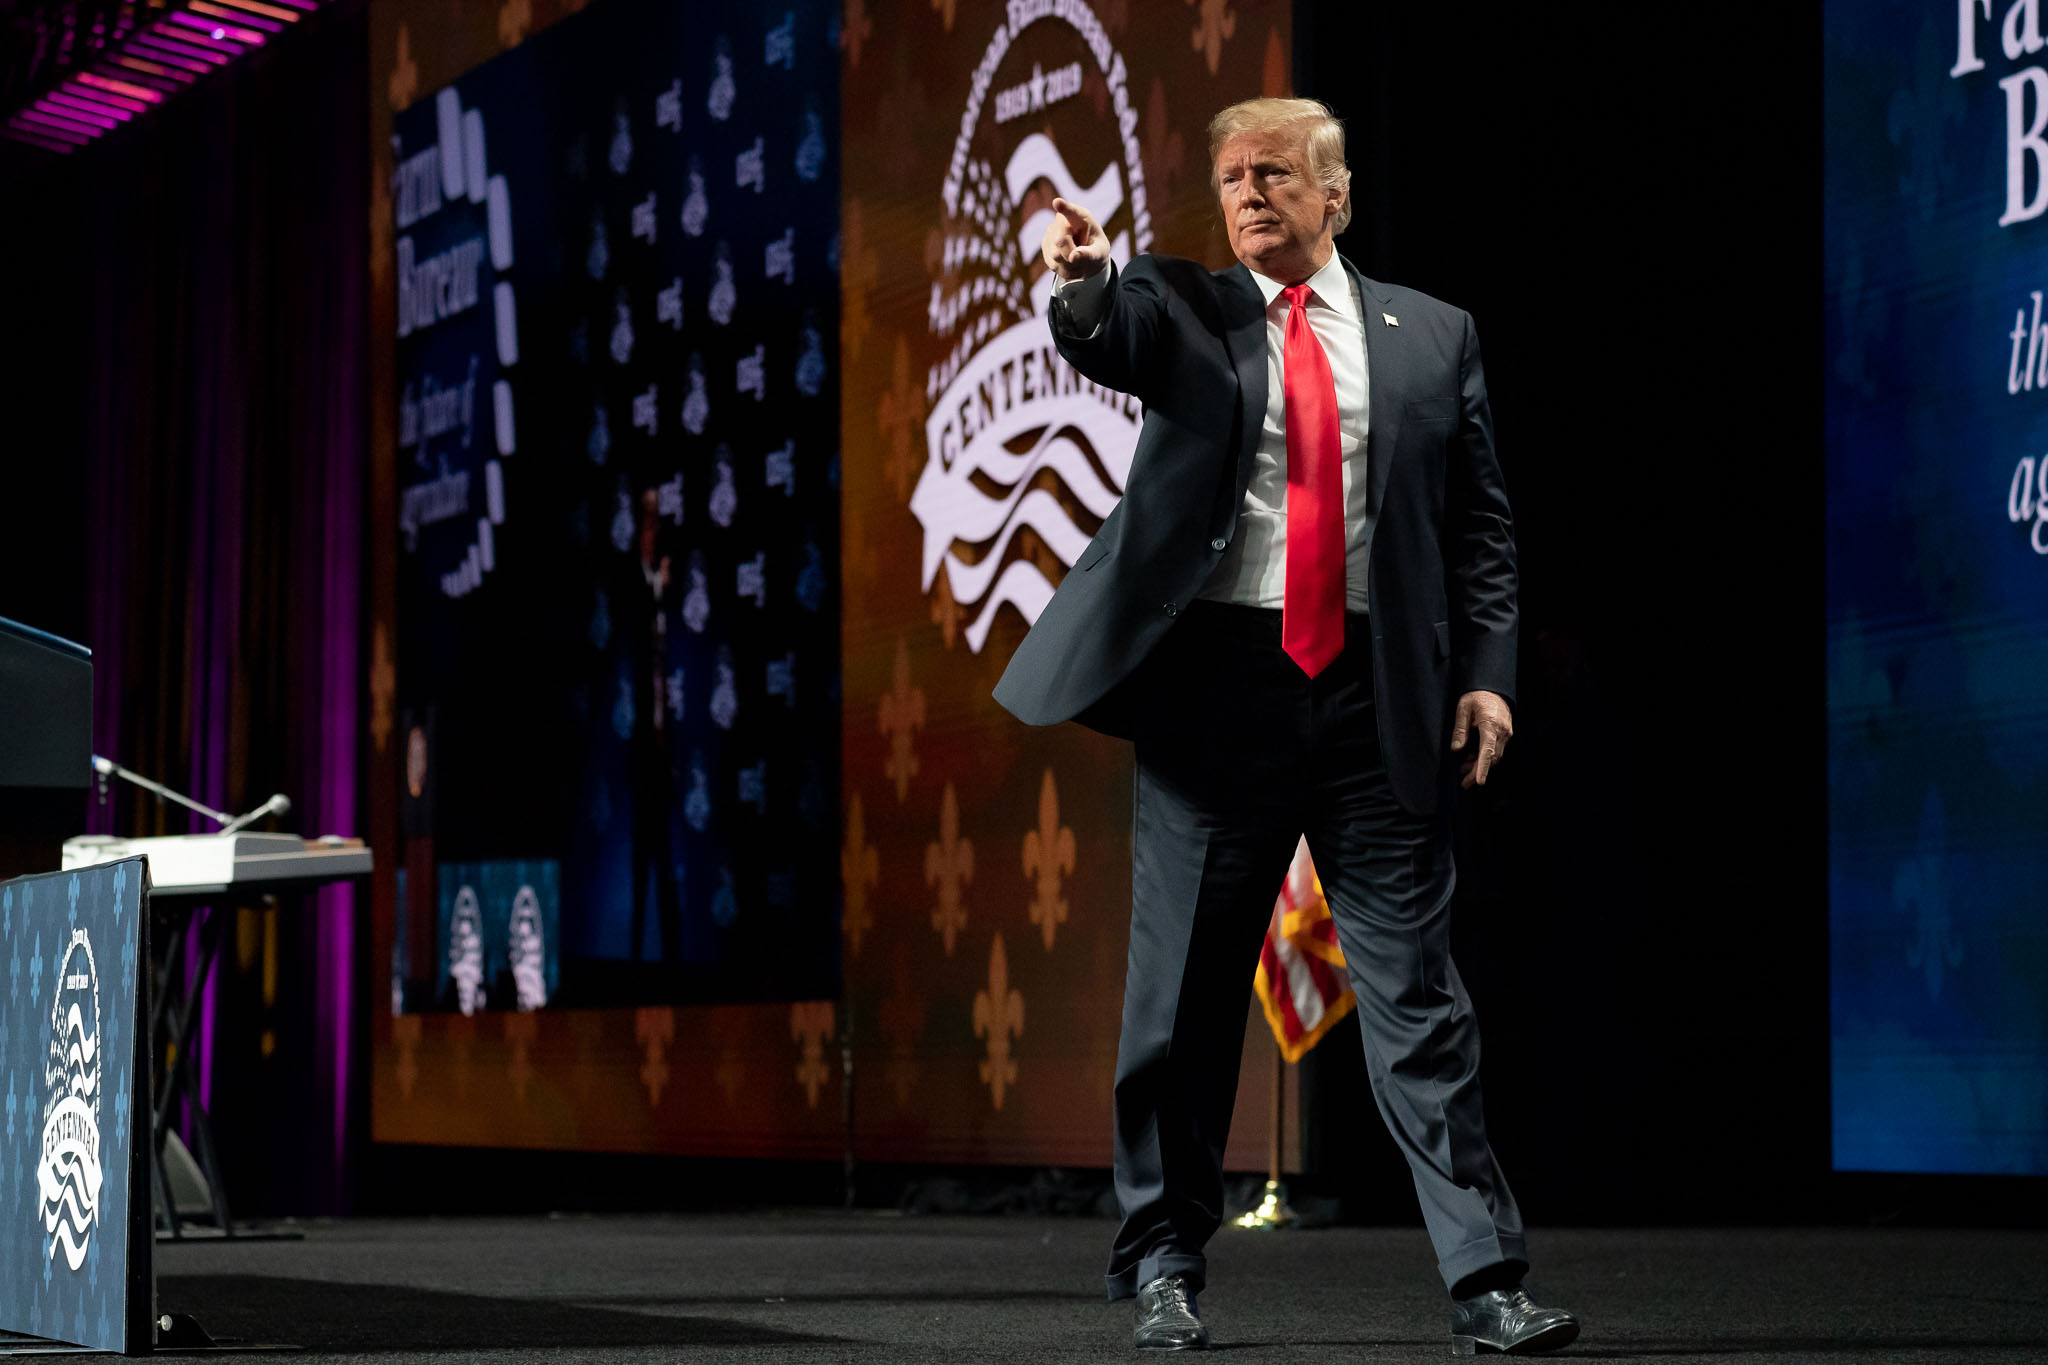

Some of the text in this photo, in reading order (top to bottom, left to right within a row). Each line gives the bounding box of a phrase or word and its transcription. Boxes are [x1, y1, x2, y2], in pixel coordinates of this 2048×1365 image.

[1950, 0, 2048, 78] Fa
[941, 346, 1137, 474] CENTENNL
[45, 1110, 95, 1167] CENTENNIAL
